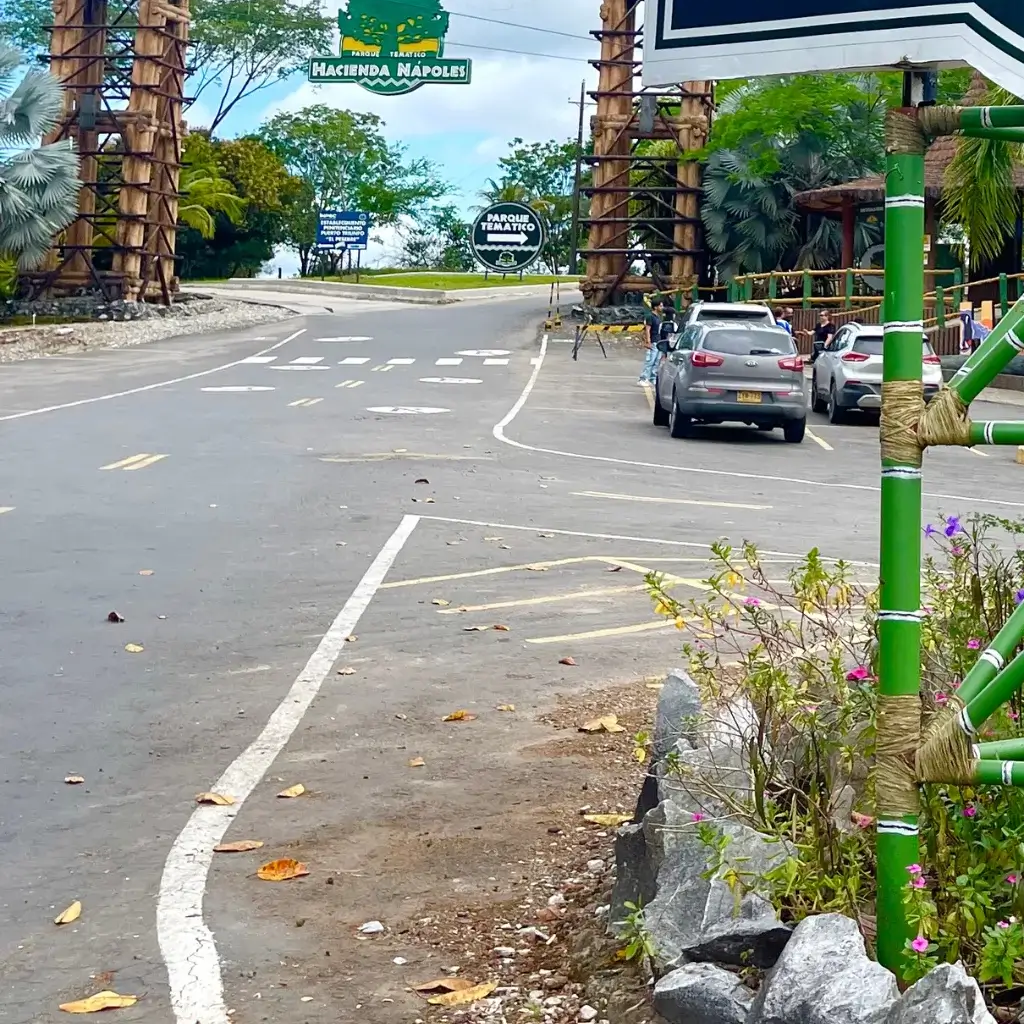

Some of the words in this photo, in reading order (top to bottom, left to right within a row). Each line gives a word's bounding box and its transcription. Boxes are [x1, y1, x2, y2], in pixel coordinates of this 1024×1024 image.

[312, 62, 390, 77] HACIENDA
[397, 60, 466, 78] NÁPOLES
[487, 214, 530, 223] PARQUE
